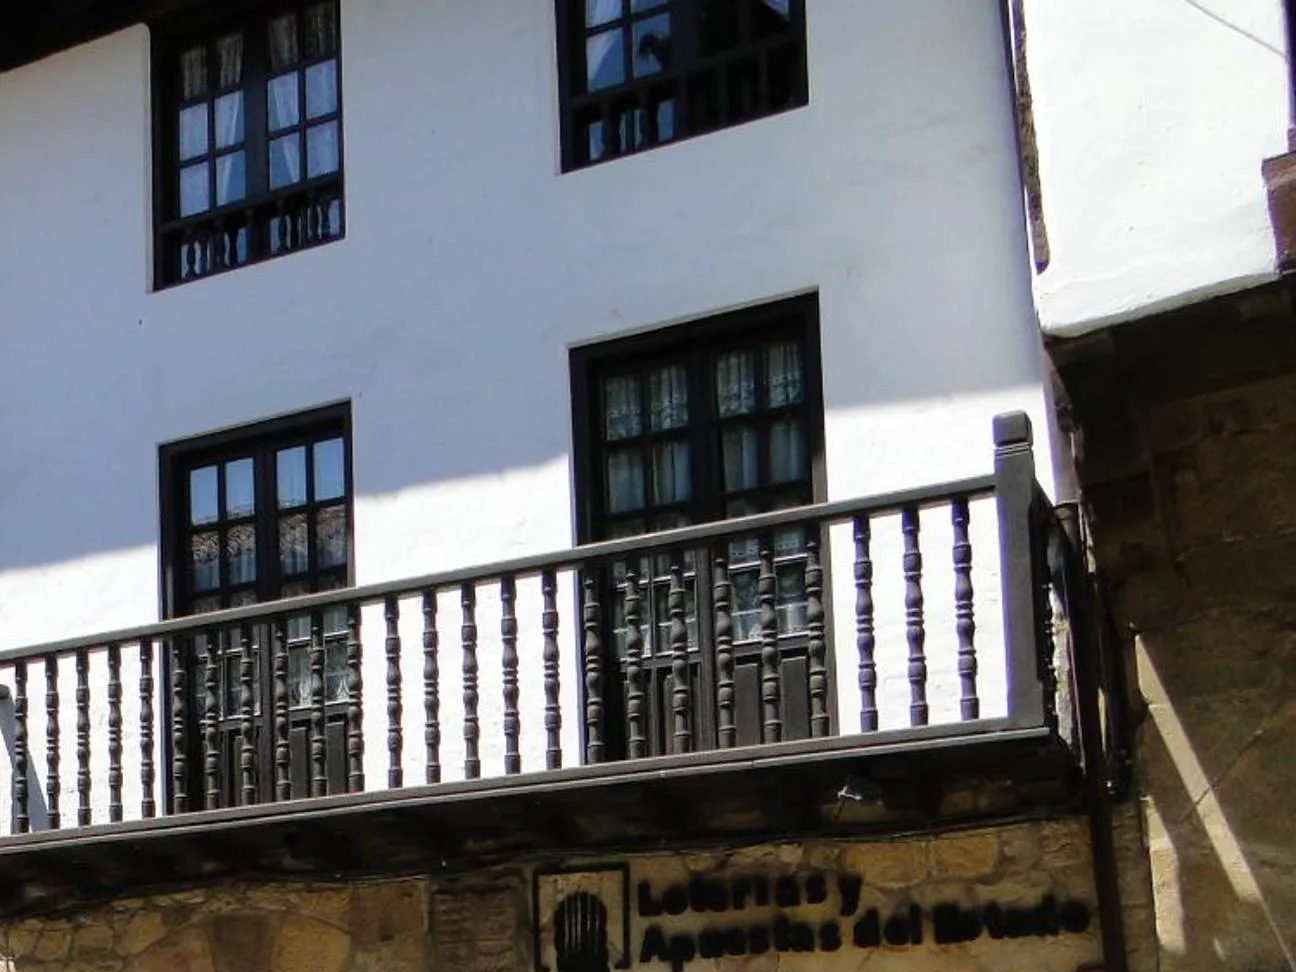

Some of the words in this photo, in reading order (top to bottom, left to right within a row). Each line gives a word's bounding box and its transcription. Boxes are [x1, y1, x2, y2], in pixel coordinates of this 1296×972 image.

[836, 873, 863, 917] y
[853, 902, 925, 949] del
[933, 893, 1091, 945] Estado
